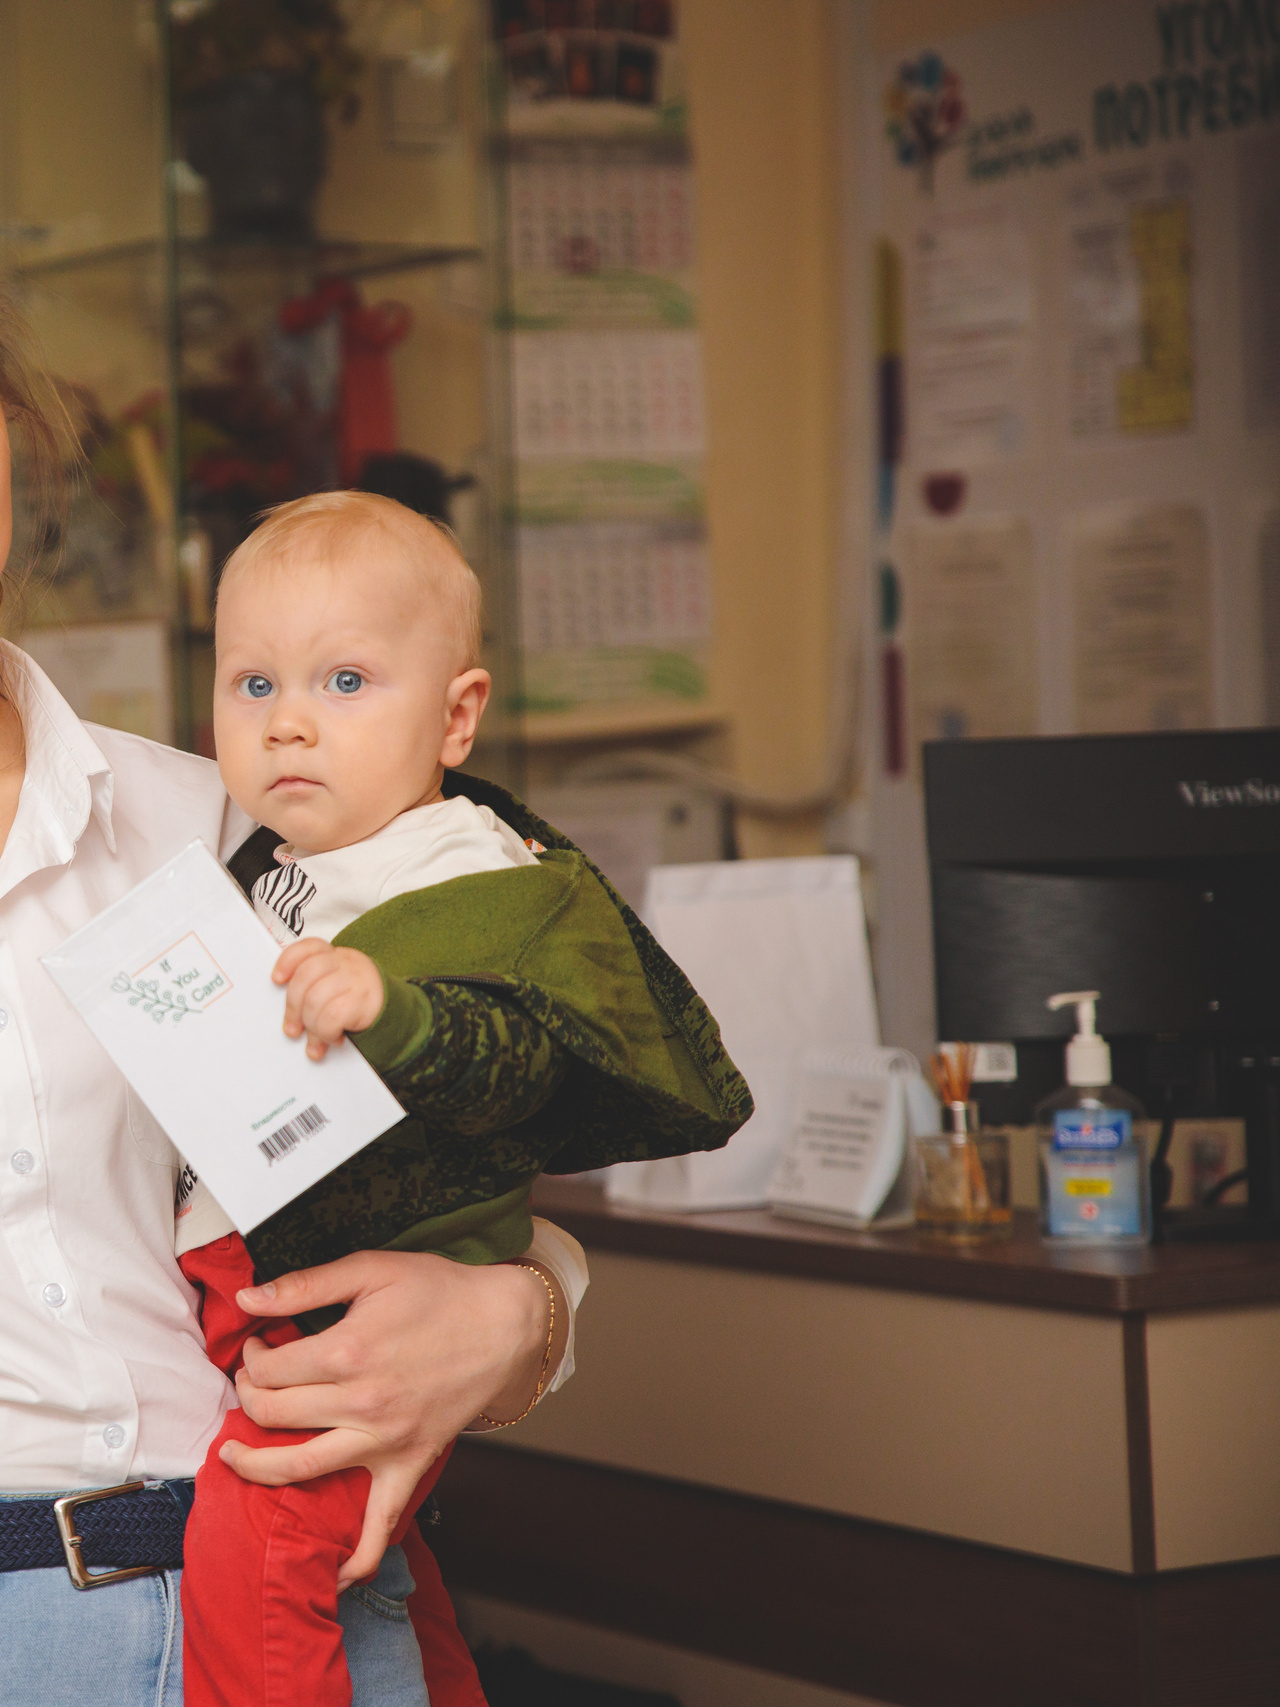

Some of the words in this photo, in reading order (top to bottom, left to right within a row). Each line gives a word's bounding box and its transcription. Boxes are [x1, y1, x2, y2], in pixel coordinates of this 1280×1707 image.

[160, 958, 172, 974] If
[172, 968, 200, 989] You
[191, 973, 224, 1003] Card
